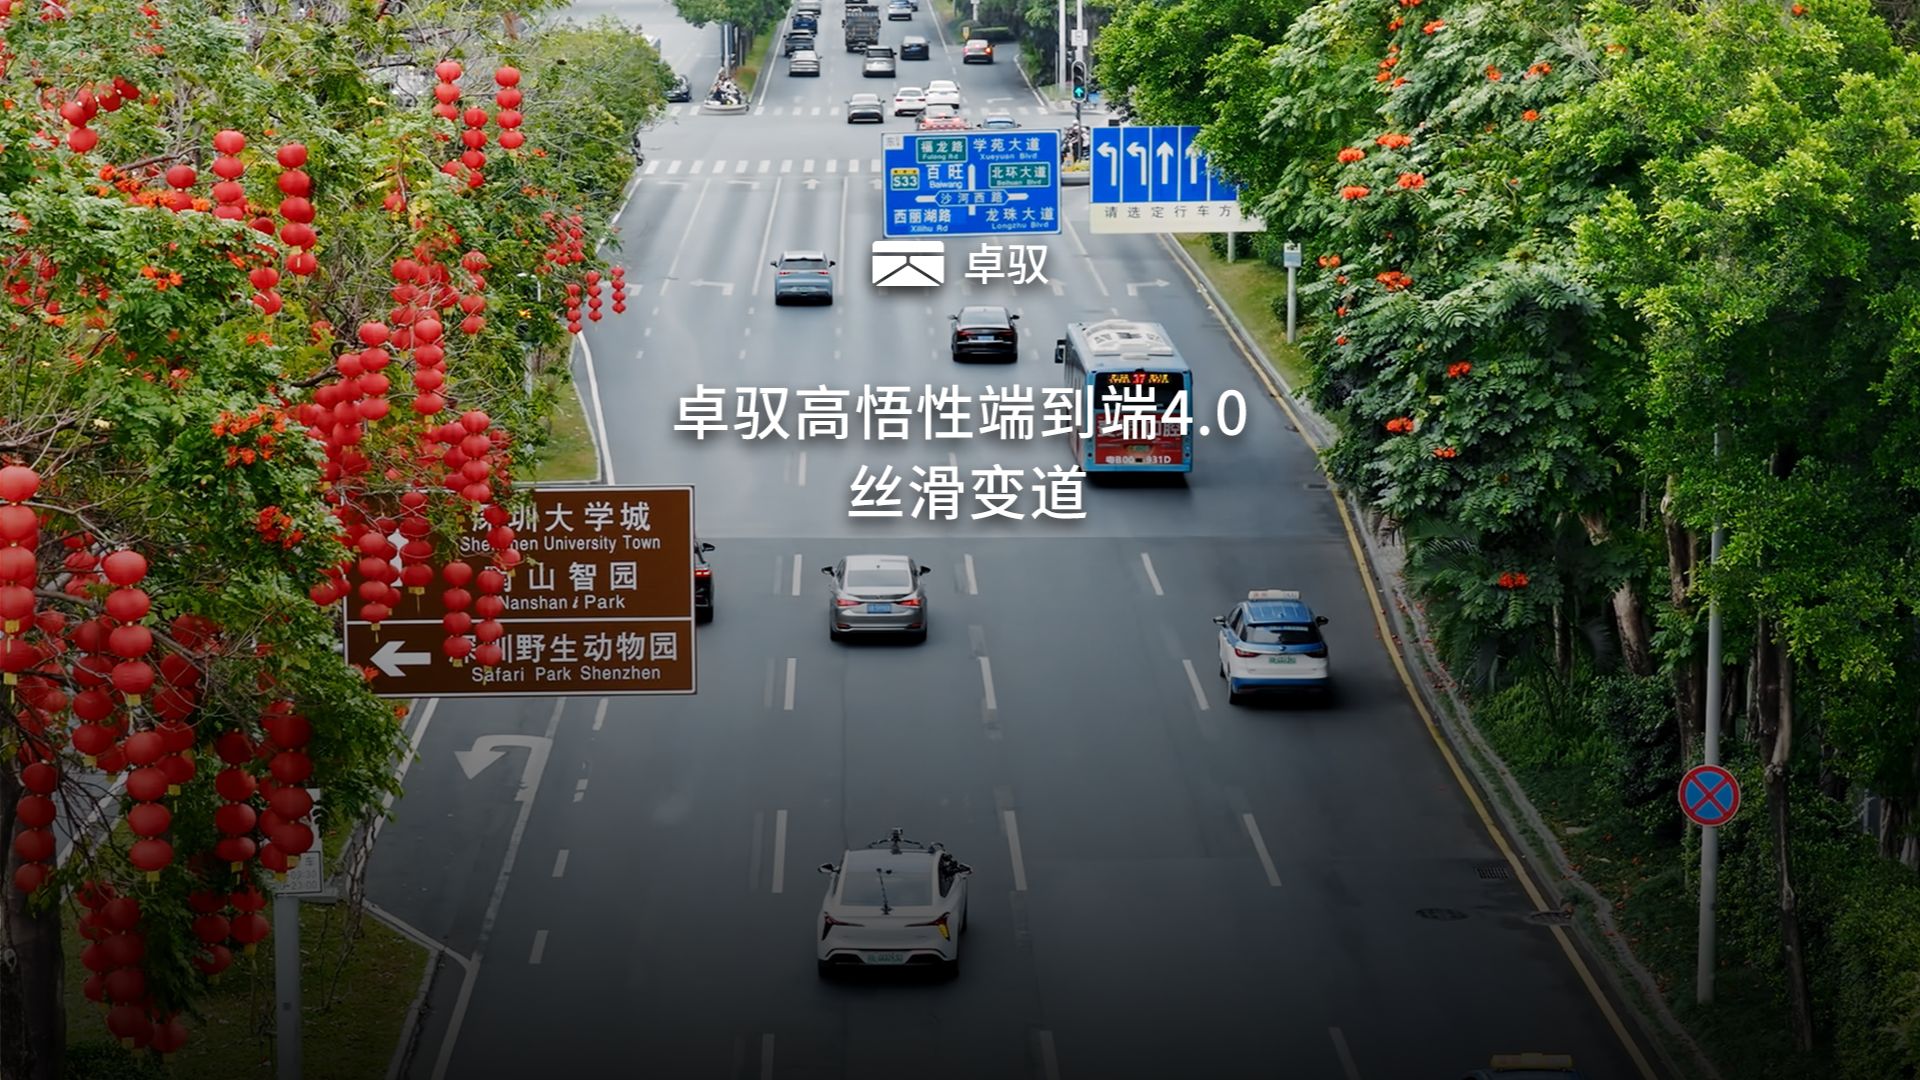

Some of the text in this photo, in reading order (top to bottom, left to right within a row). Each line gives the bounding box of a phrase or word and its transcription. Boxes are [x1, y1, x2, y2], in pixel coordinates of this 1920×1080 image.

[921, 141, 963, 153] 福龙路
[973, 138, 1040, 152] 学苑大道
[948, 153, 959, 161] Rd
[980, 152, 1038, 161] Xueyuan Blvd
[926, 164, 964, 180] 百旺
[991, 166, 1047, 179] 北环大道
[893, 176, 918, 188] S33
[928, 180, 963, 189] Baiwang
[940, 191, 1003, 205] 沙河西路
[893, 209, 951, 224] 西丽湖路
[985, 208, 1054, 222] 龙珠大道
[1104, 205, 1246, 219] 请选定行车方
[936, 224, 949, 232] Rd
[991, 221, 1050, 231] Longzhu Blvd
[460, 535, 661, 553] Shehen University Town
[495, 595, 568, 610] Nanshan
[584, 595, 625, 609] Park
[472, 665, 661, 682] Safari Park Shenzhen
